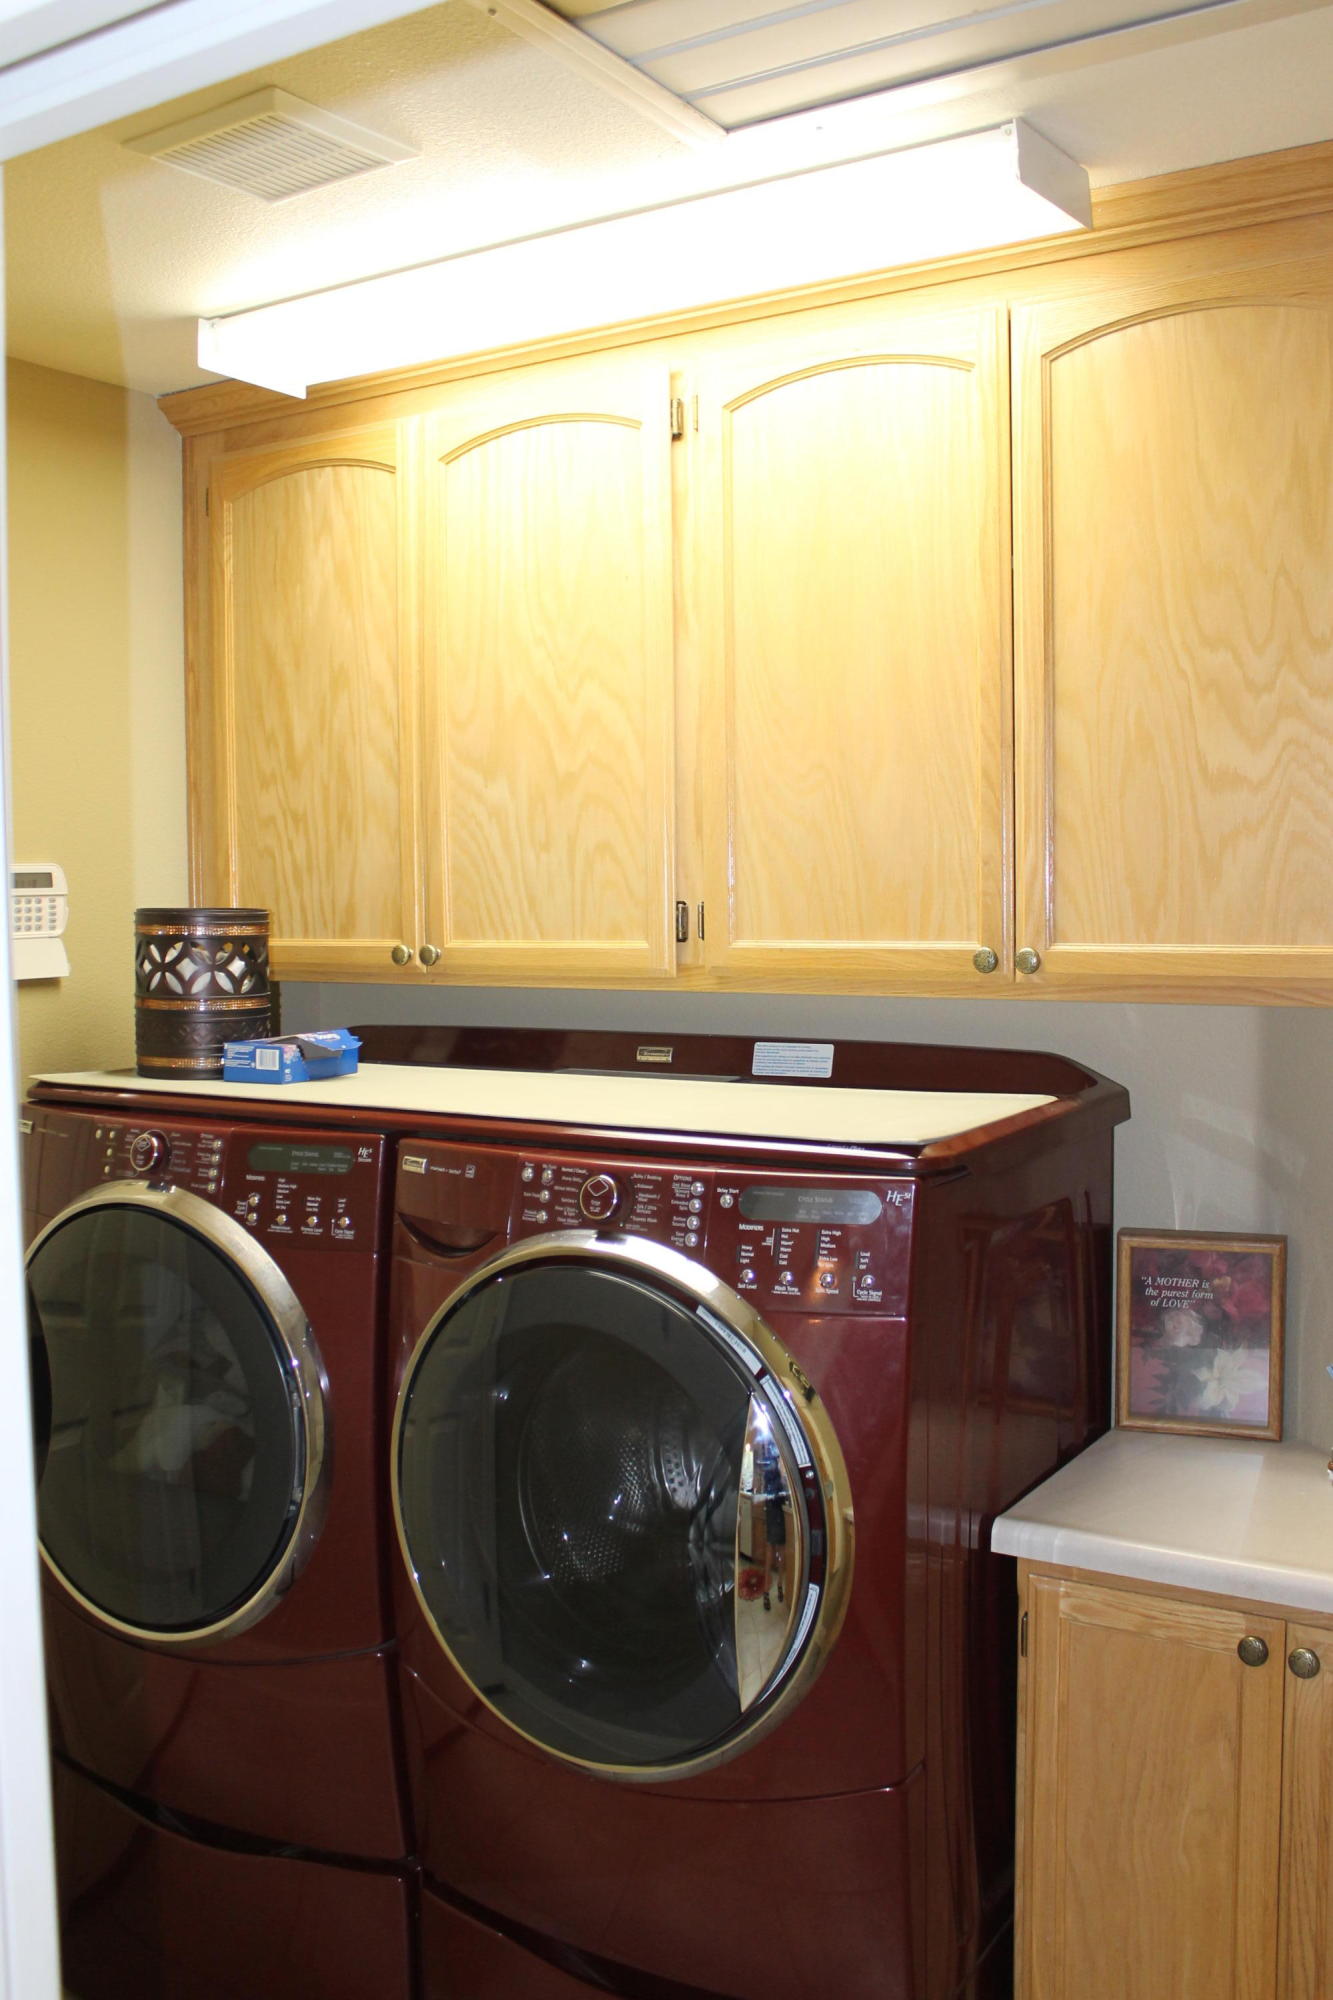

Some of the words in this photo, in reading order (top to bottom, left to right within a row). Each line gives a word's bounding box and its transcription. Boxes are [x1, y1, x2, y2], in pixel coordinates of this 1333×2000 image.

[1154, 1276, 1200, 1288] MOTHER
[1201, 1279, 1210, 1289] is
[1145, 1286, 1159, 1296] the
[1160, 1288, 1189, 1298] purest
[1192, 1288, 1214, 1299] form
[1150, 1298, 1161, 1307] of
